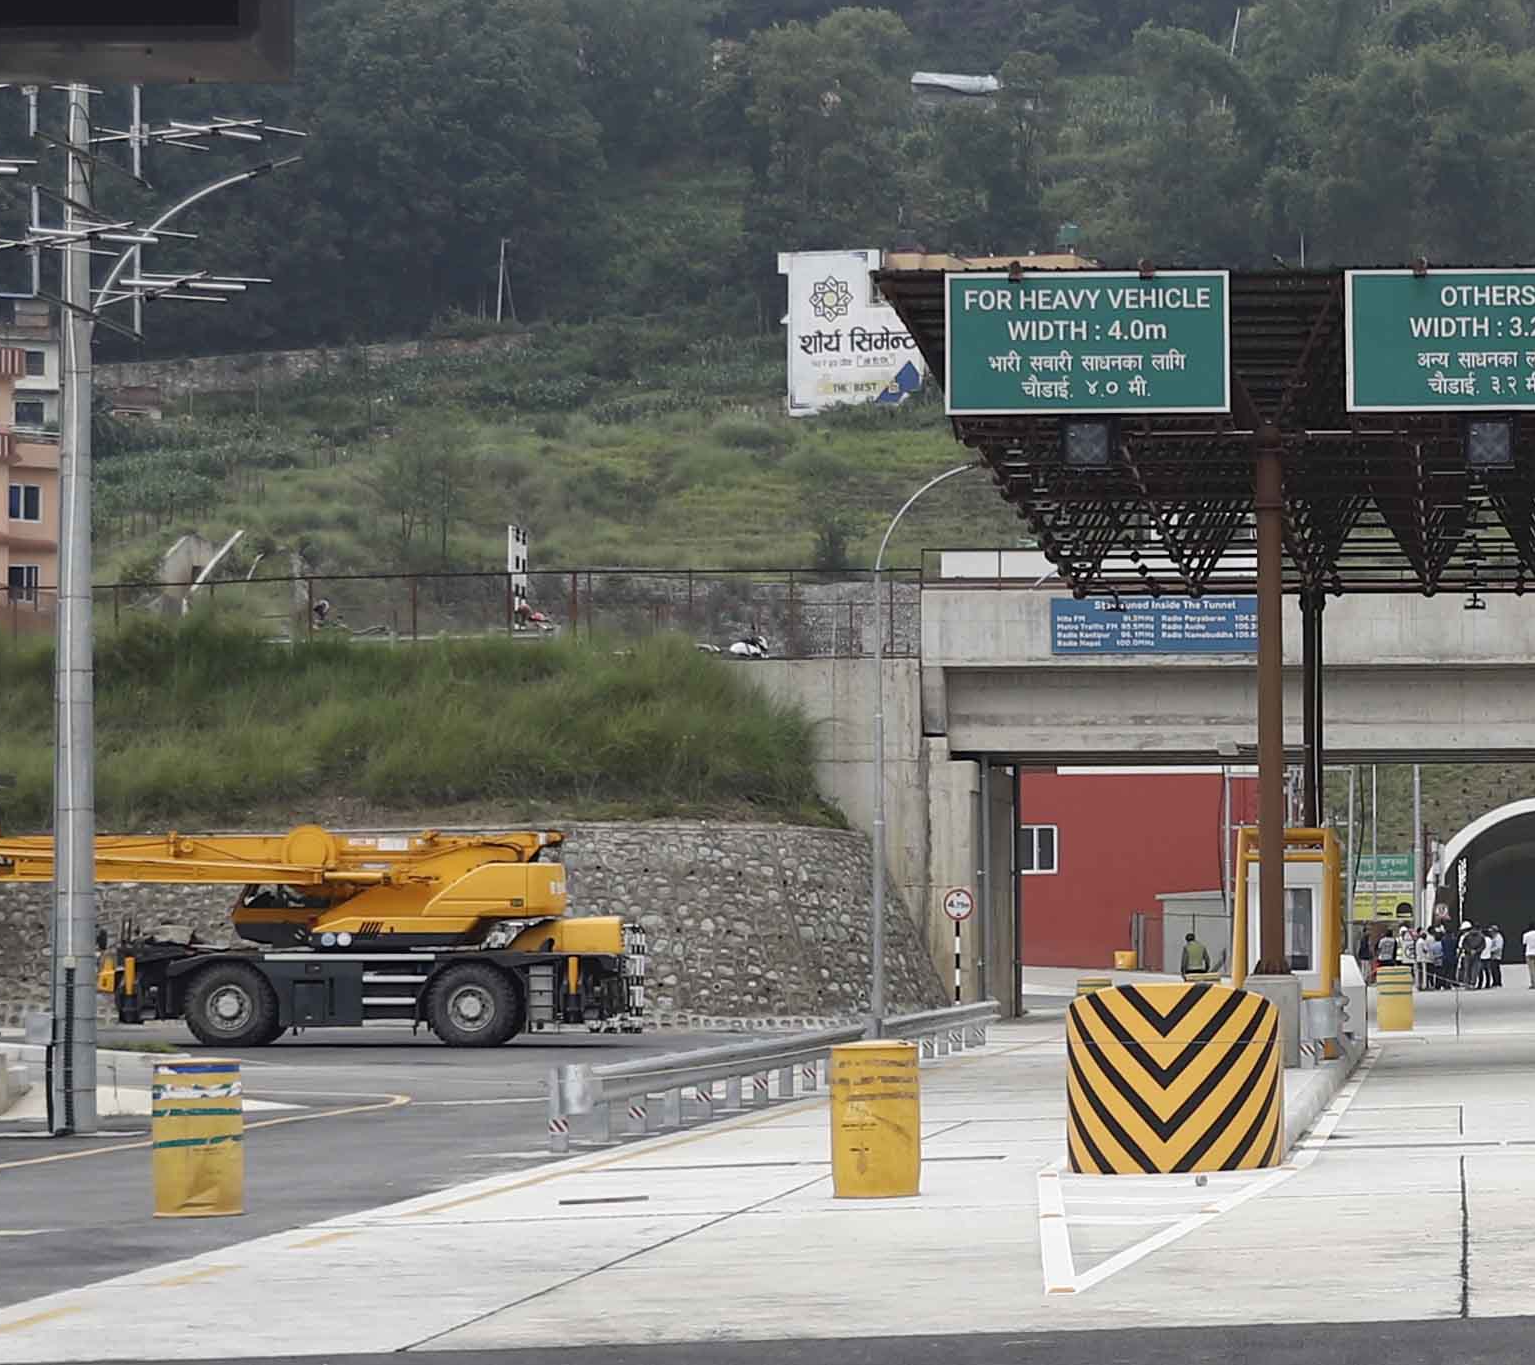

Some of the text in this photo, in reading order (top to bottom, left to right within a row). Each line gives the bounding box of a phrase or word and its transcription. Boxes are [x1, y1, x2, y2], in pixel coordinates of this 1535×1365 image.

[965, 288, 1210, 310] FOR HEAVY VEHICLE
[1441, 286, 1535, 307] OTHERS
[1008, 321, 1087, 341] WIDTH
[1108, 320, 1167, 340] 4.0m
[1409, 317, 1489, 337] WIDTH
[988, 349, 1185, 372] भारी सवारी साधनका लागि
[1417, 350, 1449, 368] अन्य
[1458, 350, 1518, 368] साधनका
[1151, 600, 1181, 610] Inside
[1183, 600, 1201, 610] The
[1203, 600, 1236, 610] Tunnel
